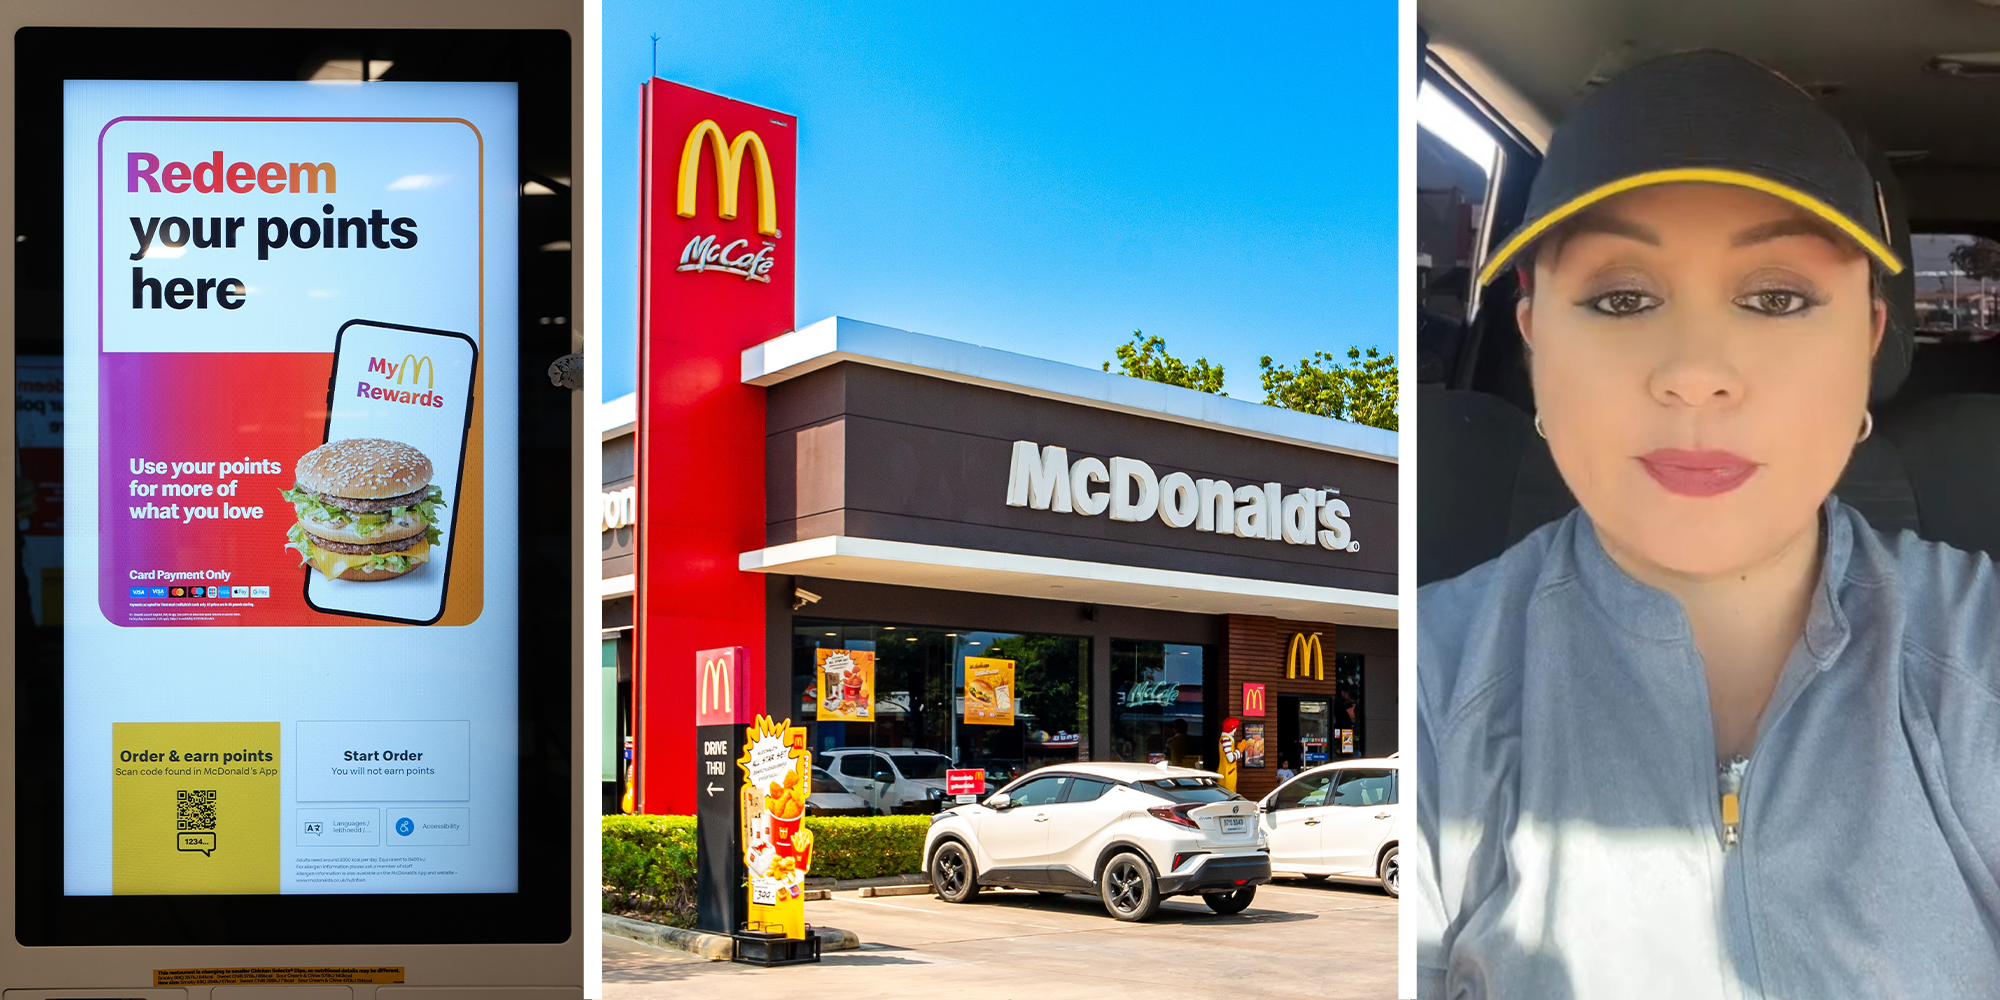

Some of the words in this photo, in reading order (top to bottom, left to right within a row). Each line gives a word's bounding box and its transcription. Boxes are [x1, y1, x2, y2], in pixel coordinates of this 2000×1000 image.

[128, 151, 337, 194] Redeem
[129, 216, 245, 260] your
[257, 203, 418, 260] points
[678, 235, 775, 281] McCafé
[133, 267, 246, 310] here
[368, 356, 399, 381] My
[356, 382, 444, 408] Rewards
[129, 457, 168, 475] Use
[171, 462, 215, 479] your
[219, 456, 282, 479] points
[129, 479, 158, 496] for
[161, 484, 213, 496] more
[217, 479, 238, 496] of
[1006, 440, 1353, 551] McDonald's
[129, 502, 179, 519] what
[183, 505, 219, 524] you
[223, 502, 264, 520] love
[129, 570, 156, 580] Card
[157, 570, 205, 582] Payment
[206, 569, 231, 582] Only
[343, 750, 379, 762] Start
[383, 750, 423, 762] Order
[704, 740, 728, 756] DRIVE
[120, 749, 165, 763] Order
[168, 750, 180, 763] &
[183, 752, 219, 763] earn
[222, 749, 273, 766] points
[115, 767, 138, 776] Scan
[140, 767, 163, 776] code
[165, 767, 192, 776] found
[194, 767, 202, 776] in
[204, 767, 259, 776] McDonald's
[259, 767, 278, 777] App
[331, 766, 348, 776] You
[350, 766, 365, 776] will
[368, 767, 383, 776] not
[407, 766, 435, 778] points
[705, 760, 727, 776] THRU
[333, 820, 366, 828] Languages
[422, 823, 460, 831] Accessibility
[184, 838, 209, 846] 1234...
